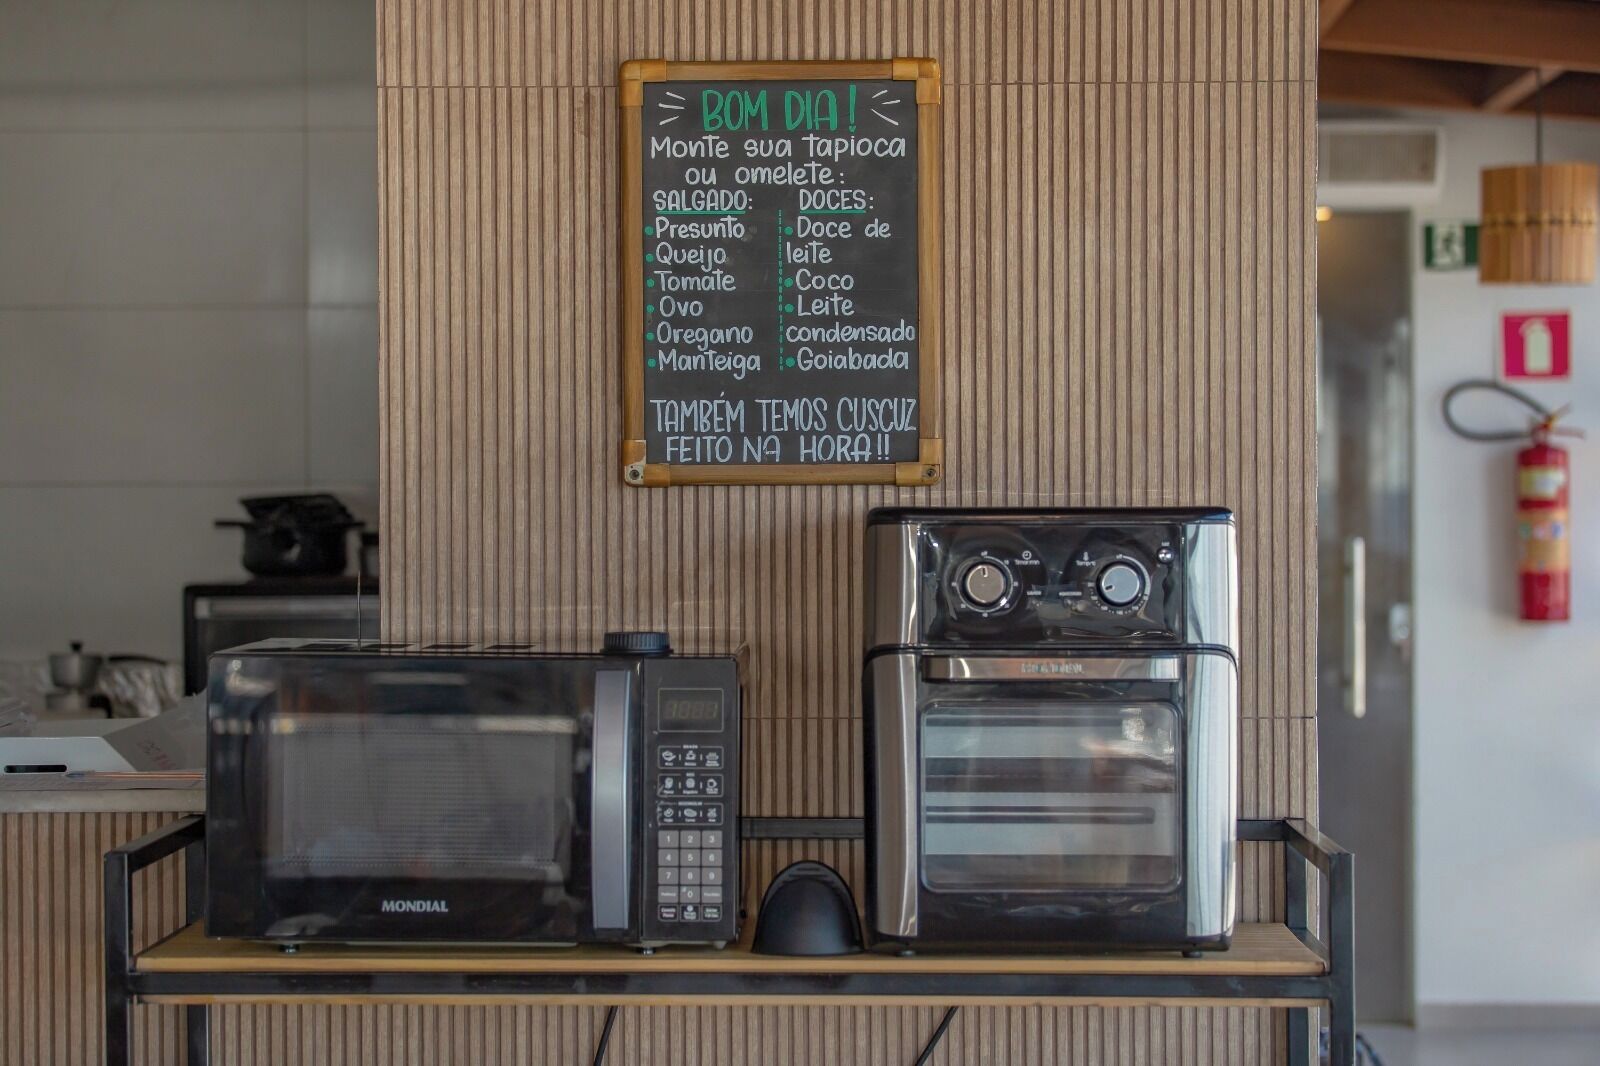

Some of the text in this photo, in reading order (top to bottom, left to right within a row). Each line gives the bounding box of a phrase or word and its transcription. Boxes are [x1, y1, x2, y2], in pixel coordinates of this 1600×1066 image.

[702, 89, 768, 131] BOM
[651, 133, 906, 162] Monte sua tapioca
[685, 161, 844, 185] ou omelete:
[653, 189, 753, 211] SALGADO:
[800, 189, 874, 210] DOCES:
[656, 215, 745, 239] Presunto
[797, 215, 891, 238] Doce de
[655, 241, 726, 272] Queijo
[786, 241, 832, 264] leite
[654, 269, 736, 292] Tomate
[795, 269, 854, 291] Coco
[659, 295, 703, 317] Ovo
[797, 292, 854, 316] Leite
[657, 321, 753, 351] Oregano
[786, 319, 915, 342] condensado
[658, 348, 761, 380] Manteiga
[797, 347, 909, 371] Goiabada
[650, 392, 917, 433] TAMBÉM TEMOS CUSCUZ
[666, 433, 889, 463] FEITO NA HORA!!
[381, 900, 448, 912] MONDIAL
